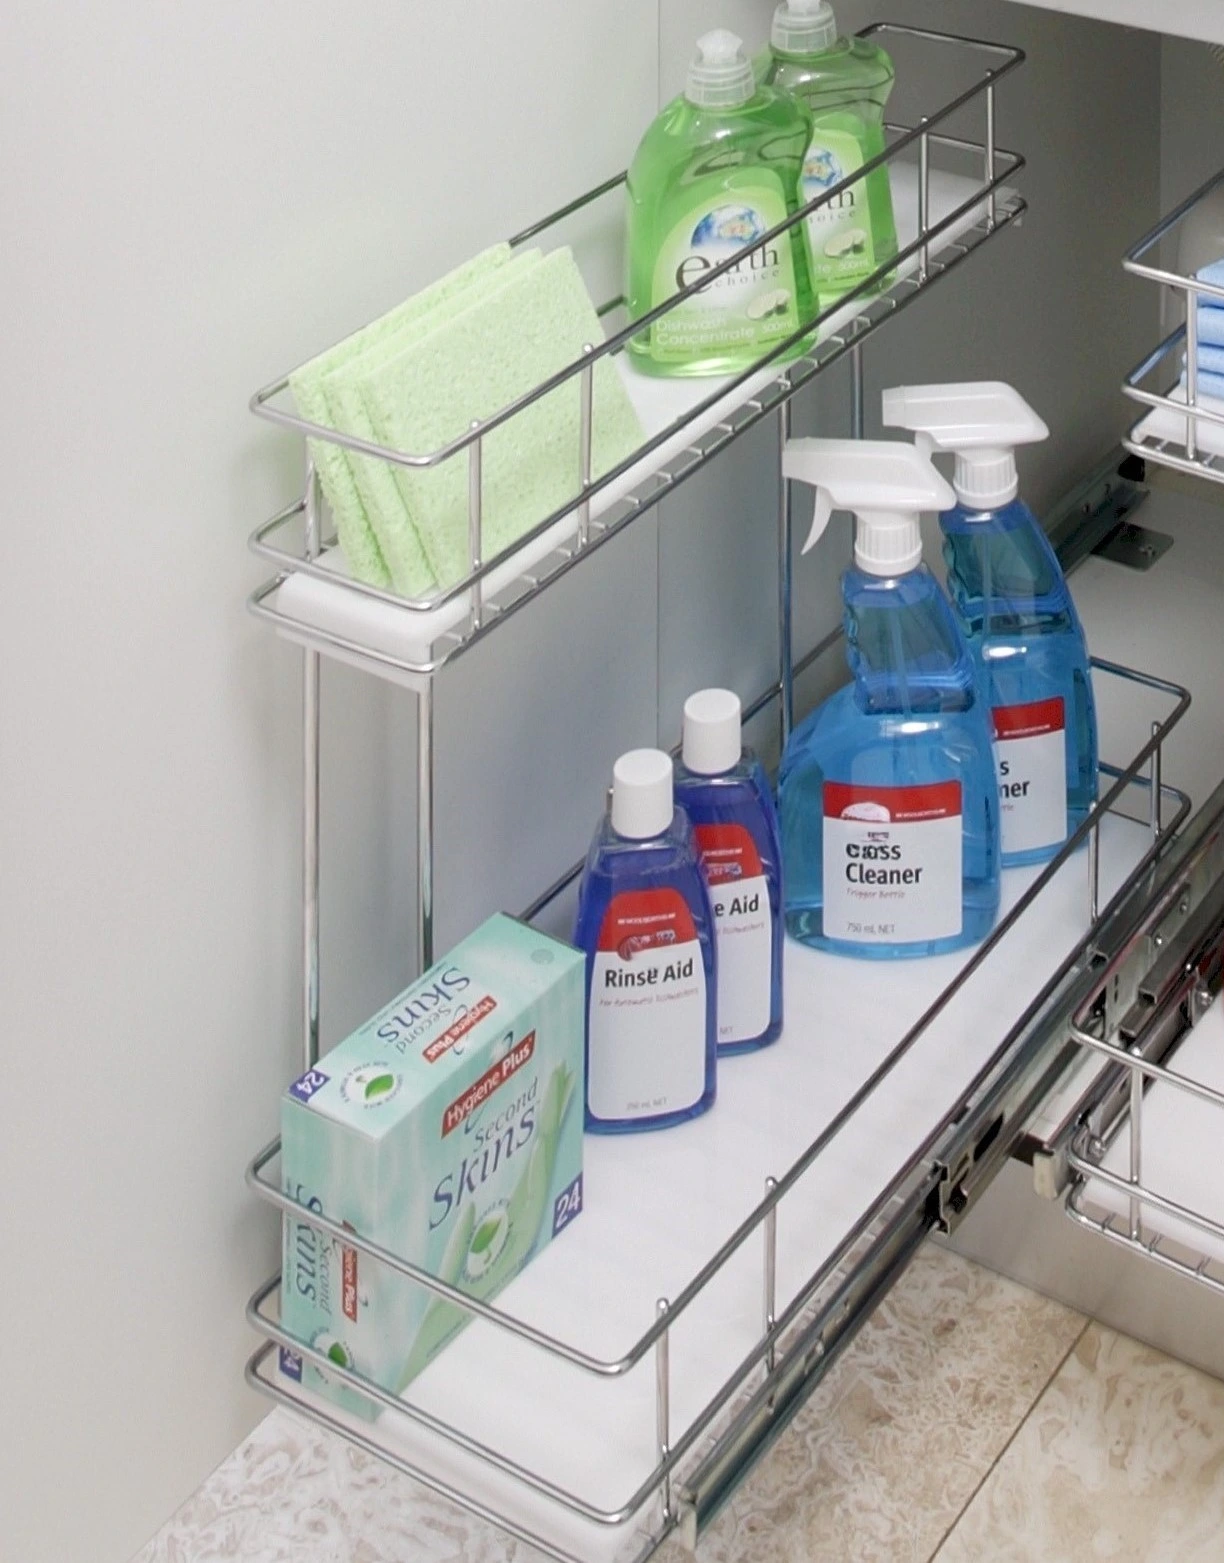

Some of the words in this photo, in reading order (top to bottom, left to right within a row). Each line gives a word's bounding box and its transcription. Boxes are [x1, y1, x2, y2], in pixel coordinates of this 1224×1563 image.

[845, 862, 923, 885] Cleaner
[728, 892, 760, 916] Aid
[604, 966, 659, 989] Rinse
[662, 957, 694, 983] Aid
[377, 966, 470, 1044] Skins
[395, 1003, 452, 1055] Second
[296, 1071, 325, 1095] 24
[446, 1070, 501, 1128] Hygiene
[502, 1043, 531, 1078] Plus
[473, 1075, 539, 1147] Second
[429, 1107, 535, 1231] Skins
[555, 1180, 581, 1229] 24
